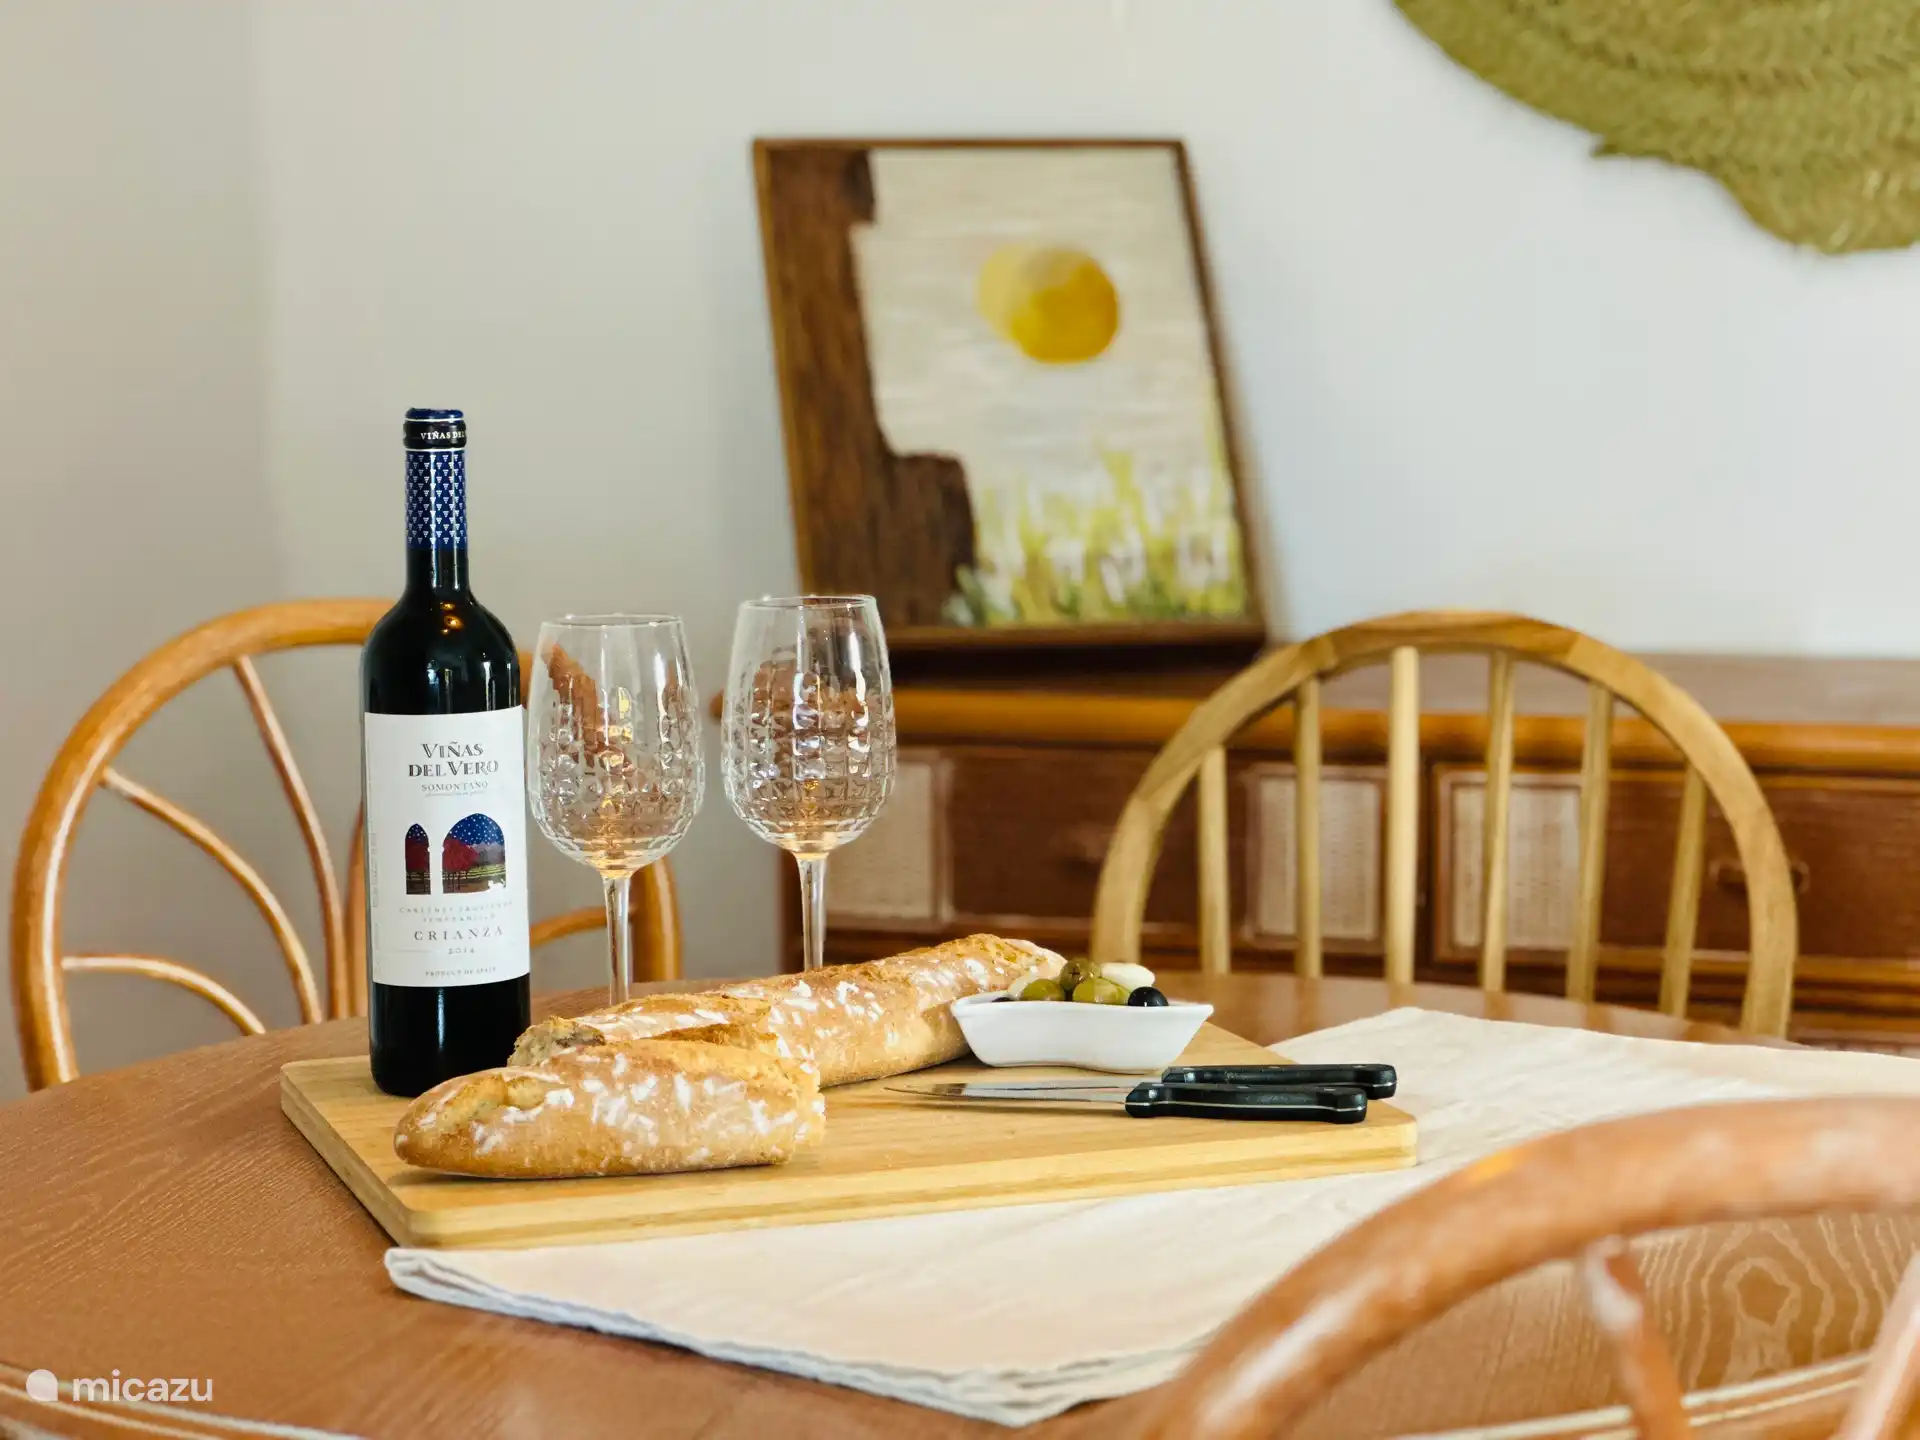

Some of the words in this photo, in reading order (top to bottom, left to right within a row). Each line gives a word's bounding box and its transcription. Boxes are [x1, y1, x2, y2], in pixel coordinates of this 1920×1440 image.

[420, 431, 451, 440] VIÑAS
[421, 741, 484, 758] VIÑAS
[408, 764, 446, 777] DEL
[446, 760, 499, 776] VERO
[421, 780, 488, 792] SOMONTANO
[414, 926, 503, 941] CRIANZA
